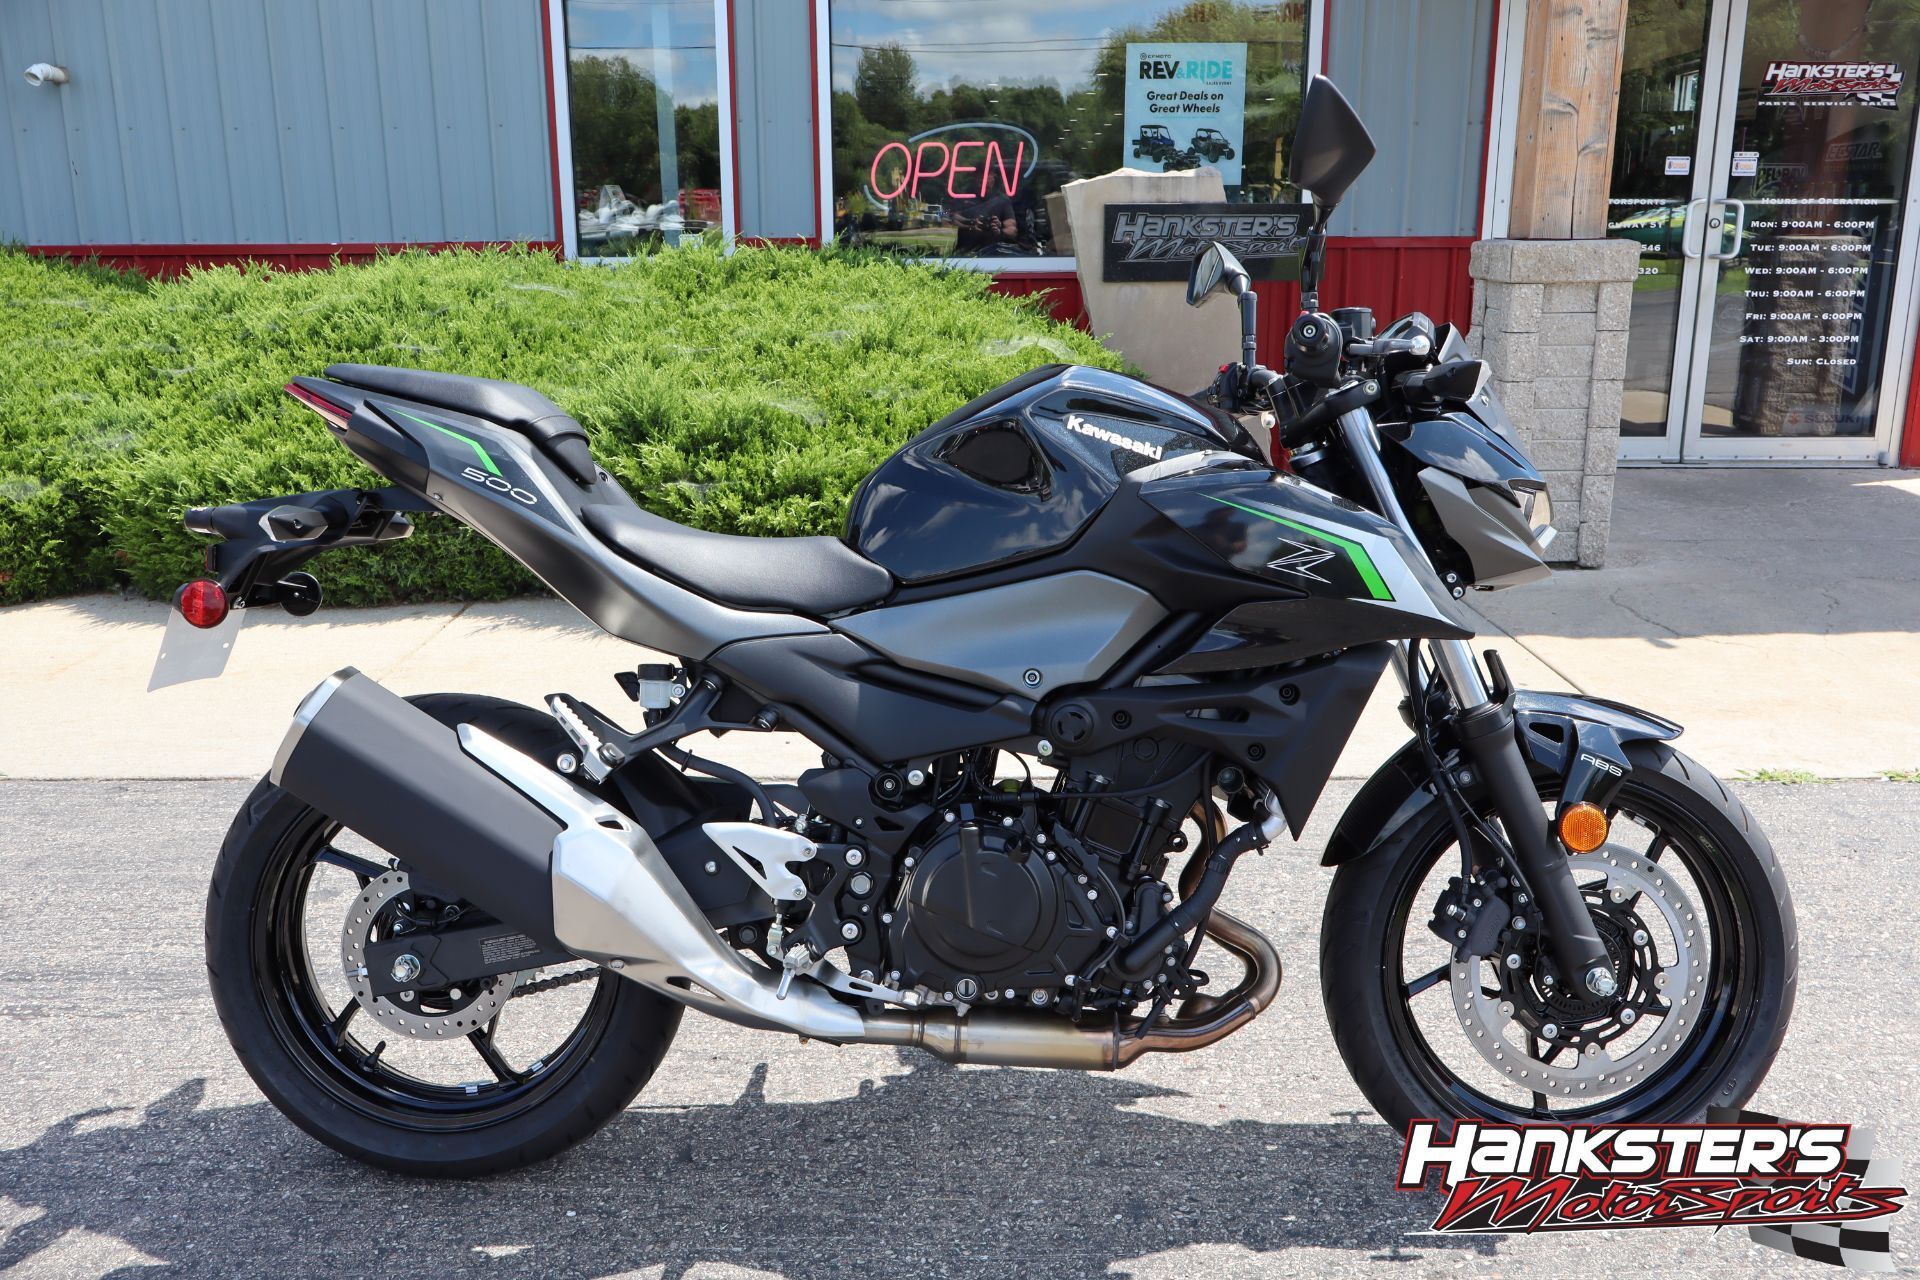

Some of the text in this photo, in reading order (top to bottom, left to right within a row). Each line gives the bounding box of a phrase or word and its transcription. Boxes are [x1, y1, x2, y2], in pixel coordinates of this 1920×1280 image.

[1146, 90, 1224, 101] Great Deals on
[1149, 103, 1221, 113] Great Wheels
[870, 140, 1025, 200] OPEN
[1781, 220, 1823, 228] 9:00AM
[1833, 220, 1875, 229] 6:00PM
[1778, 243, 1820, 252] 9:00AM
[1830, 243, 1872, 252] 6:00PM
[1775, 266, 1817, 275] 9:00AM
[1827, 266, 1869, 275] 6:00PM
[1772, 289, 1814, 298] 9:00AM
[1824, 289, 1866, 298] 6:00PM
[1770, 312, 1811, 321] 9:00AM
[1821, 312, 1863, 321] 6:00PM
[1767, 335, 1808, 343] 9:00AM
[1818, 335, 1860, 343] 3:00PM
[1065, 414, 1164, 462] Kawasaki
[459, 466, 538, 506] 500
[1580, 752, 1623, 777] ABS
